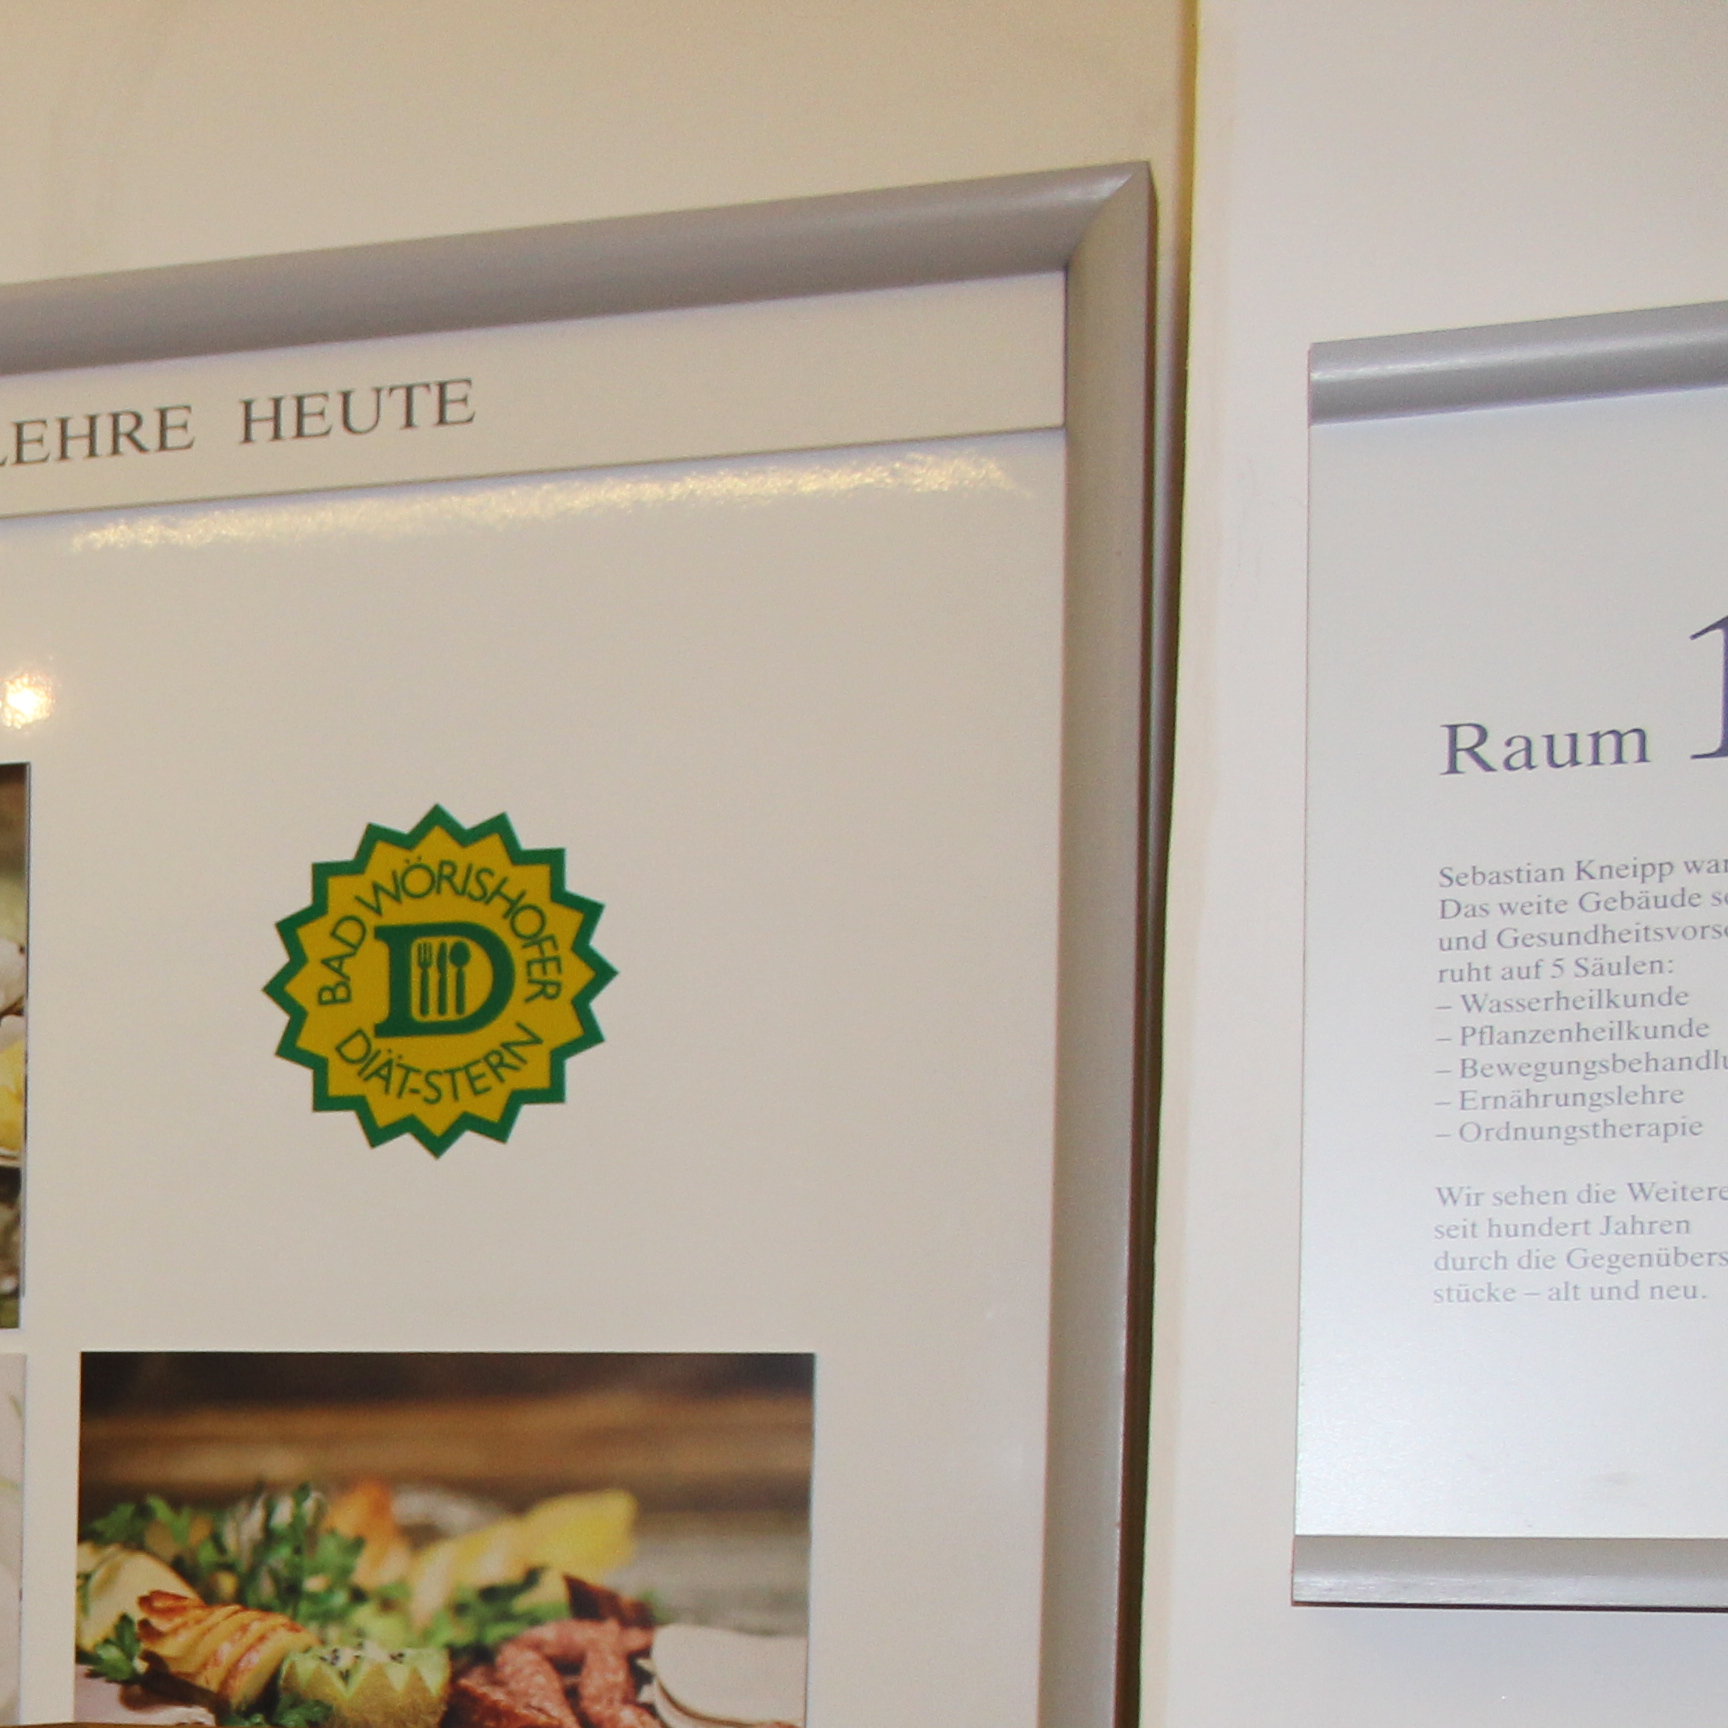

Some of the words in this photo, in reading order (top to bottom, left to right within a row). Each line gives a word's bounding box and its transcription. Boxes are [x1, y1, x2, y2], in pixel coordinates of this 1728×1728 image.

[238, 378, 476, 445] HEUTE
[1439, 721, 1651, 775] Raum
[1439, 862, 1565, 888] Sebastian
[1575, 857, 1674, 883] Kneipp
[1439, 897, 1489, 920] Das
[1499, 895, 1568, 915] weite
[1578, 887, 1702, 913] Gebäude
[318, 915, 367, 1006] BAD
[355, 856, 562, 1003] WÖRISHOFER
[1438, 930, 1487, 952] und
[1438, 962, 1492, 983] ruht
[1501, 959, 1543, 980] auf
[1550, 958, 1564, 978] 5
[1574, 956, 1674, 978] Säulen:
[1461, 985, 1689, 1014] Wasserheilkunde
[1460, 1017, 1709, 1046] Pflanzenheilkunde
[335, 1022, 544, 1104] DIÄT-STERN
[1459, 1084, 1685, 1112] Ernährungslehre
[1459, 1116, 1704, 1145] Ordnungstherapie
[1436, 1186, 1484, 1207] Wir
[1492, 1184, 1567, 1206] sehen
[1576, 1183, 1616, 1204] die
[1434, 1218, 1478, 1239] seit
[1488, 1216, 1592, 1238] hundert
[1600, 1215, 1690, 1235] Jahren
[1434, 1250, 1508, 1271] durch
[1517, 1249, 1556, 1270] die
[1433, 1282, 1516, 1303] stücke
[1548, 1281, 1580, 1301] alt
[1590, 1279, 1640, 1300] und
[1650, 1283, 1707, 1300] neu.
